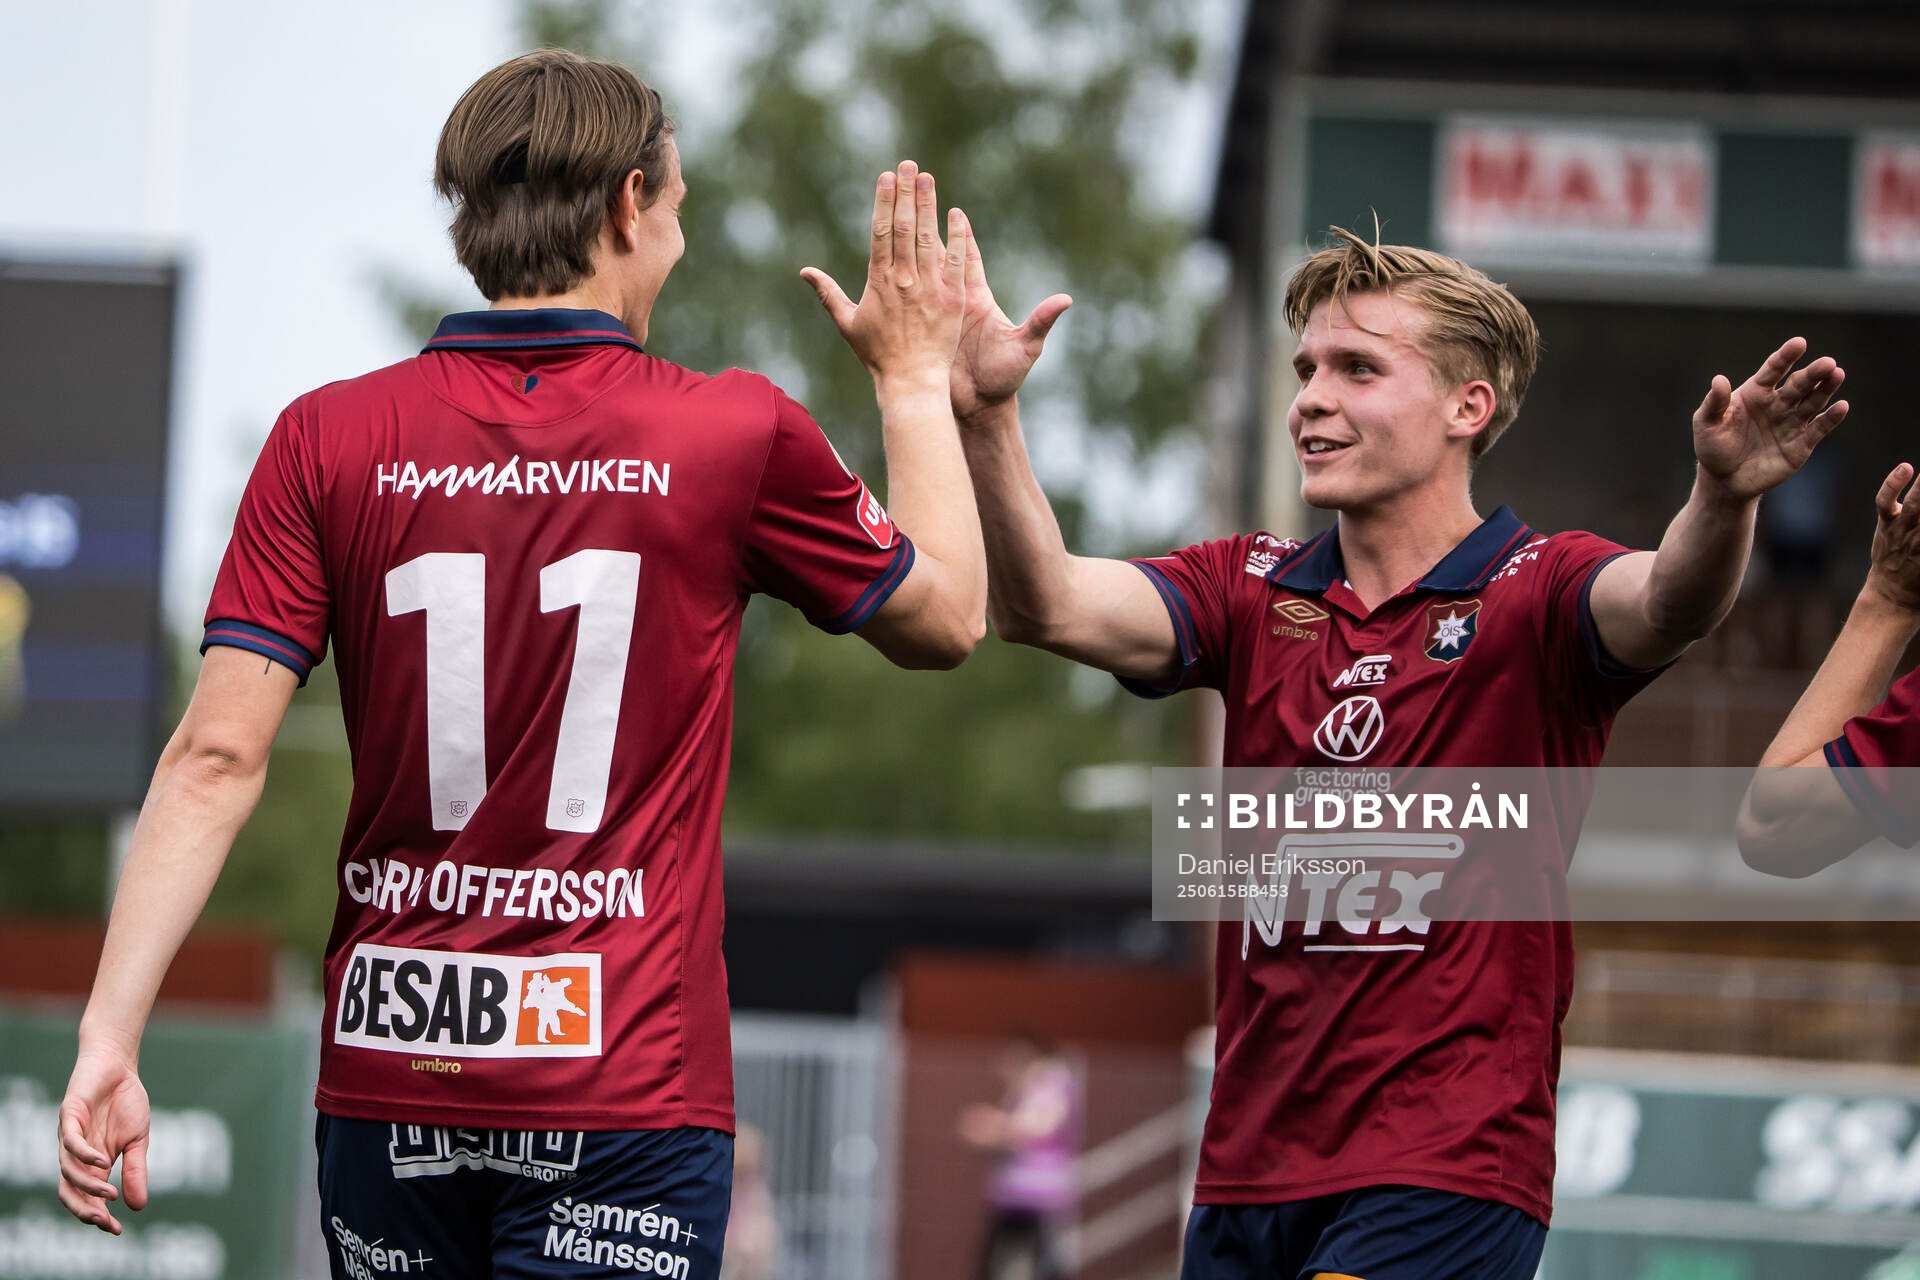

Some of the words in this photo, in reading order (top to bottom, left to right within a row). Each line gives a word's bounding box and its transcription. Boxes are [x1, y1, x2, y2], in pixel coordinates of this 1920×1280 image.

[1272, 625, 1319, 640] umbro
[385, 549, 641, 833] 11
[1294, 767, 1391, 793] factoring
[340, 956, 509, 1046] BESAB
[411, 1058, 461, 1074] umbro
[543, 1227, 690, 1280] Månsson
